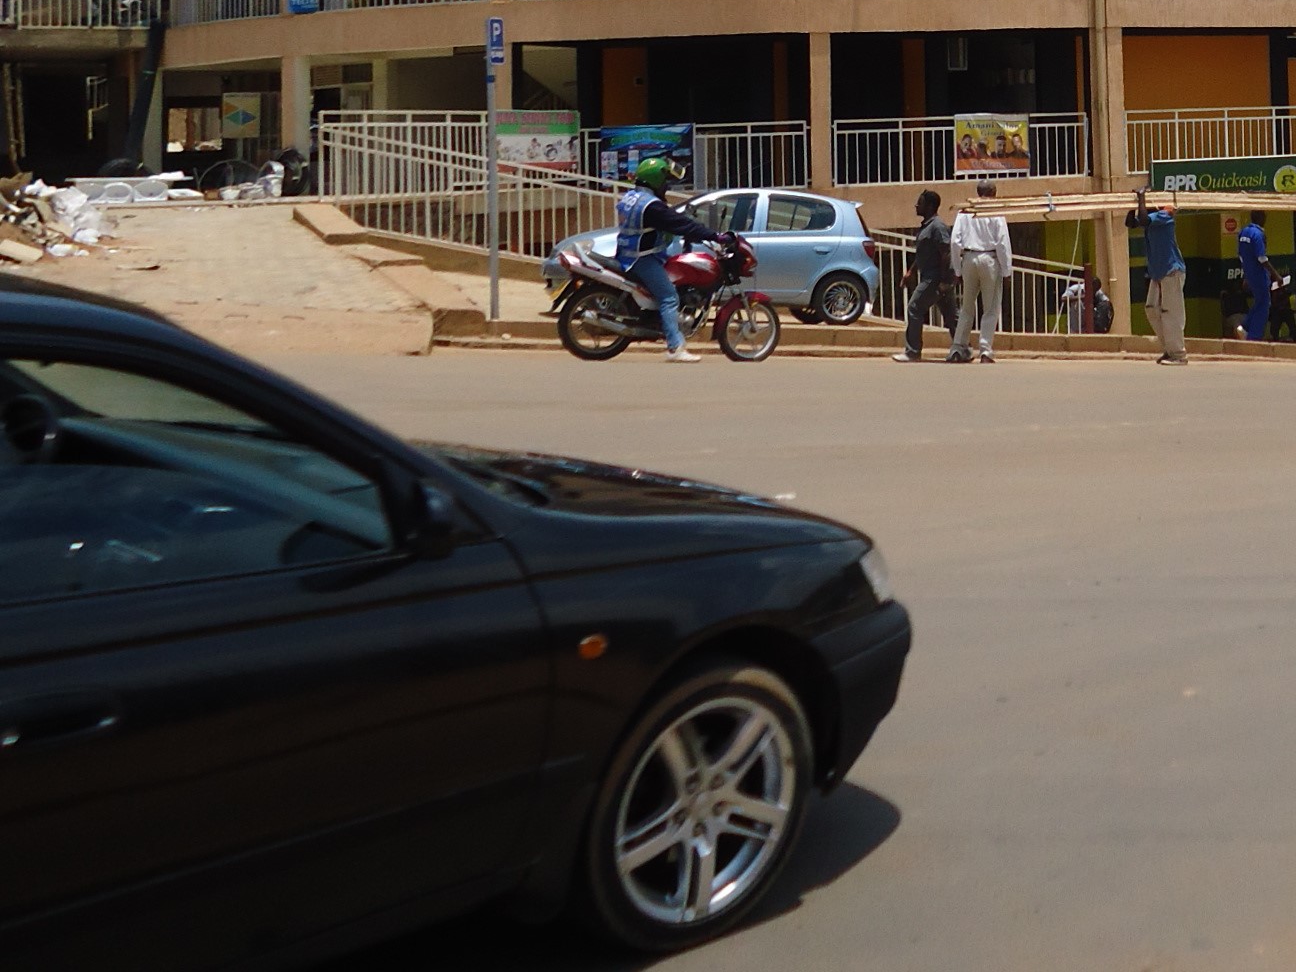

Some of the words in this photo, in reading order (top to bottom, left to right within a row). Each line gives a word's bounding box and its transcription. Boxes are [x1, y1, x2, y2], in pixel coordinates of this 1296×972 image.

[492, 22, 501, 42] P
[1164, 174, 1197, 191] BPR
[1199, 171, 1267, 191] Quickcash
